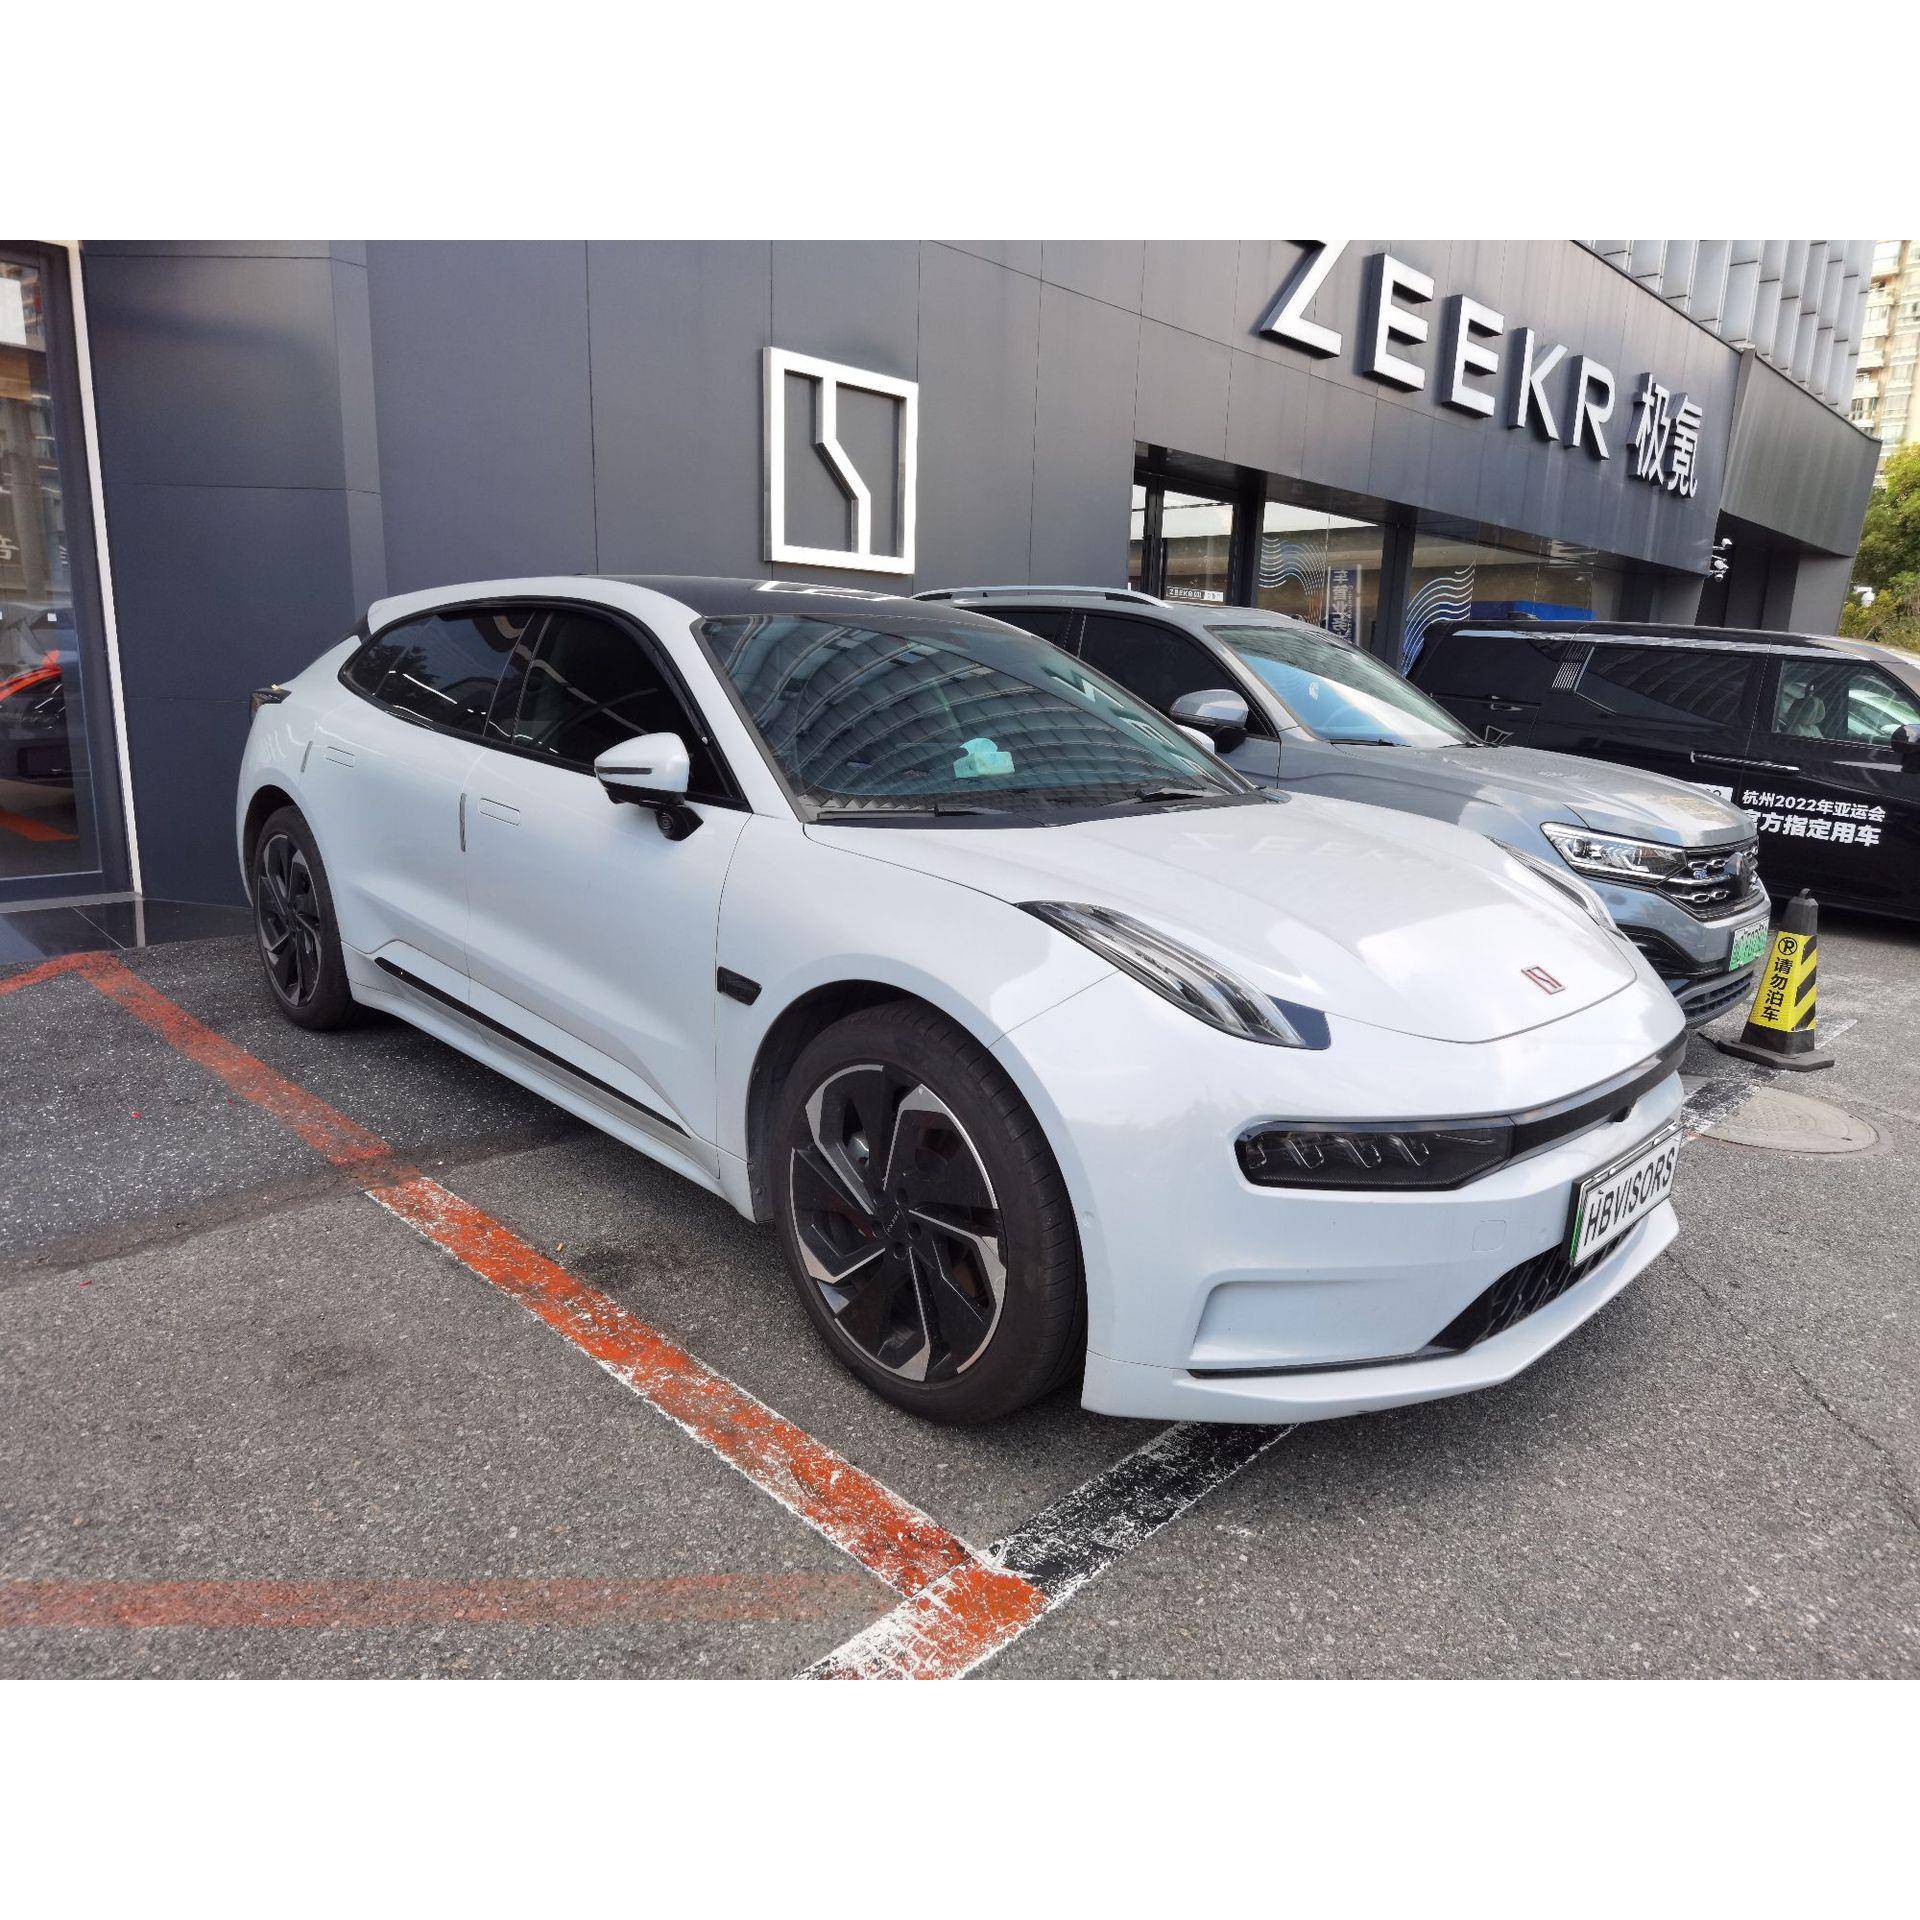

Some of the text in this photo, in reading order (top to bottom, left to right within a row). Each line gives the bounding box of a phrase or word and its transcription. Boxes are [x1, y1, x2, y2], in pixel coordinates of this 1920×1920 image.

[1260, 240, 1702, 498] ZEEKR 极氪
[1742, 789, 1887, 823] 杭州2022年亚运会
[1761, 956, 1794, 1022] 请勿泊车
[1584, 1146, 1675, 1247] HBVISORS
